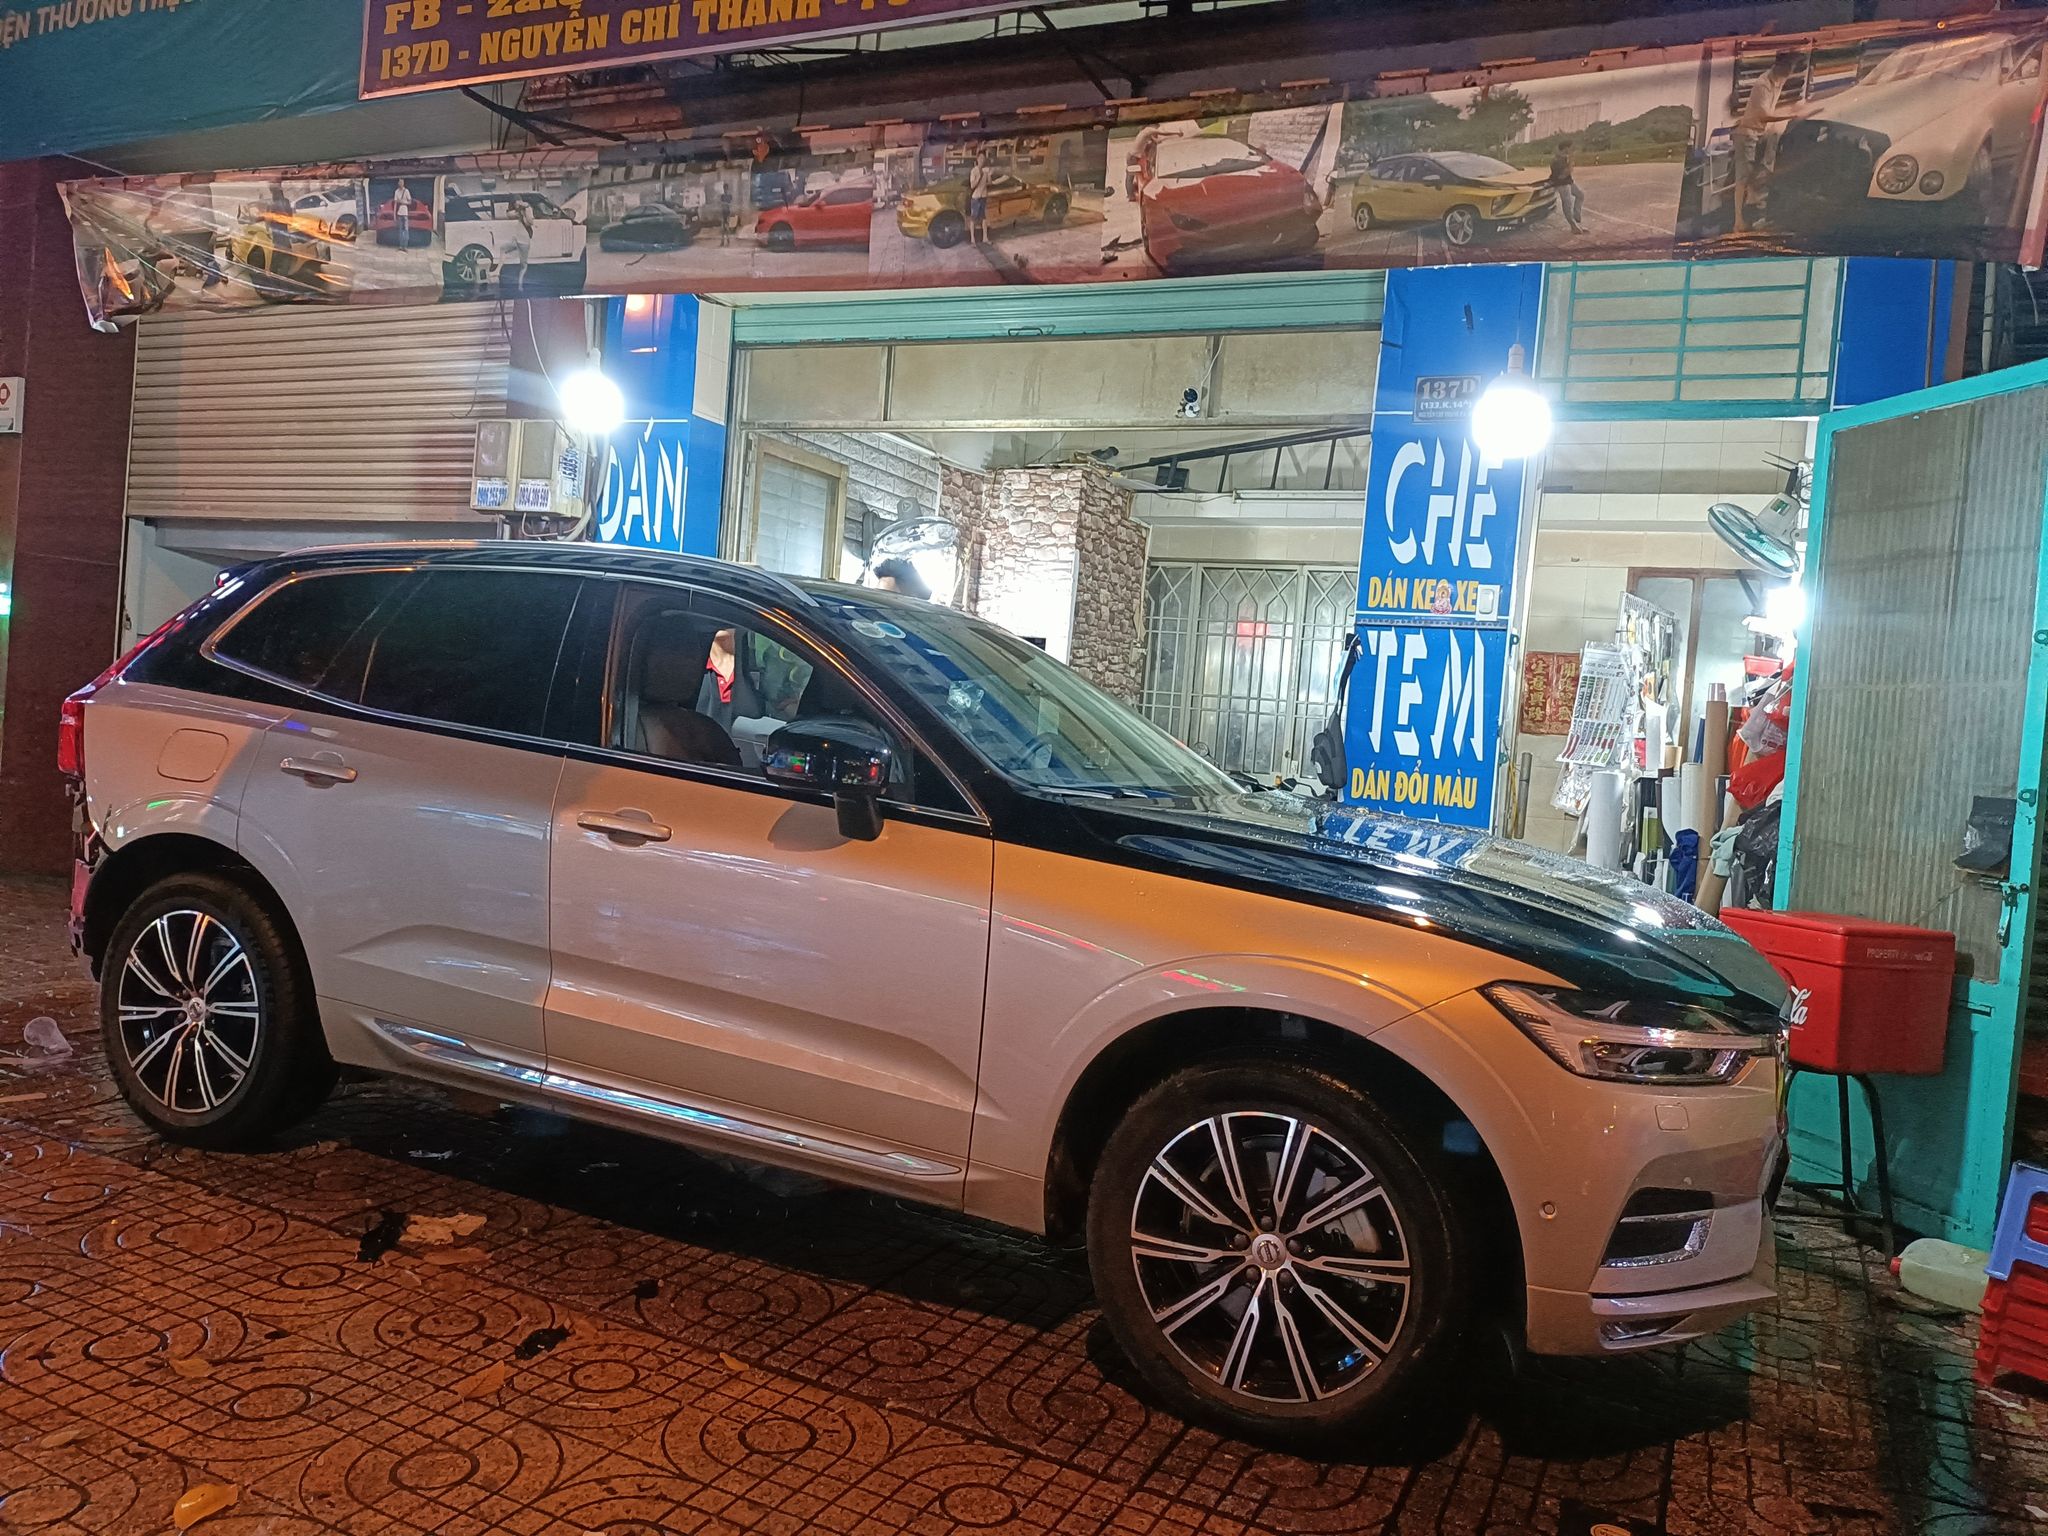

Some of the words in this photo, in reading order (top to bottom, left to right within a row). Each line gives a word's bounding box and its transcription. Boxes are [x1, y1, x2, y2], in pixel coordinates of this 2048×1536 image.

[380, 40, 450, 80] 137D
[479, 8, 610, 65] NGUYỄN
[620, 0, 680, 44] CHÍ
[384, 0, 441, 35] FB
[599, 416, 684, 543] DÁN
[1367, 570, 1409, 609] DÁN
[1367, 627, 1485, 762] TEM
[1350, 761, 1391, 801] DÁN
[1394, 759, 1430, 805] ĐỔI
[1433, 768, 1478, 810] MÀU
